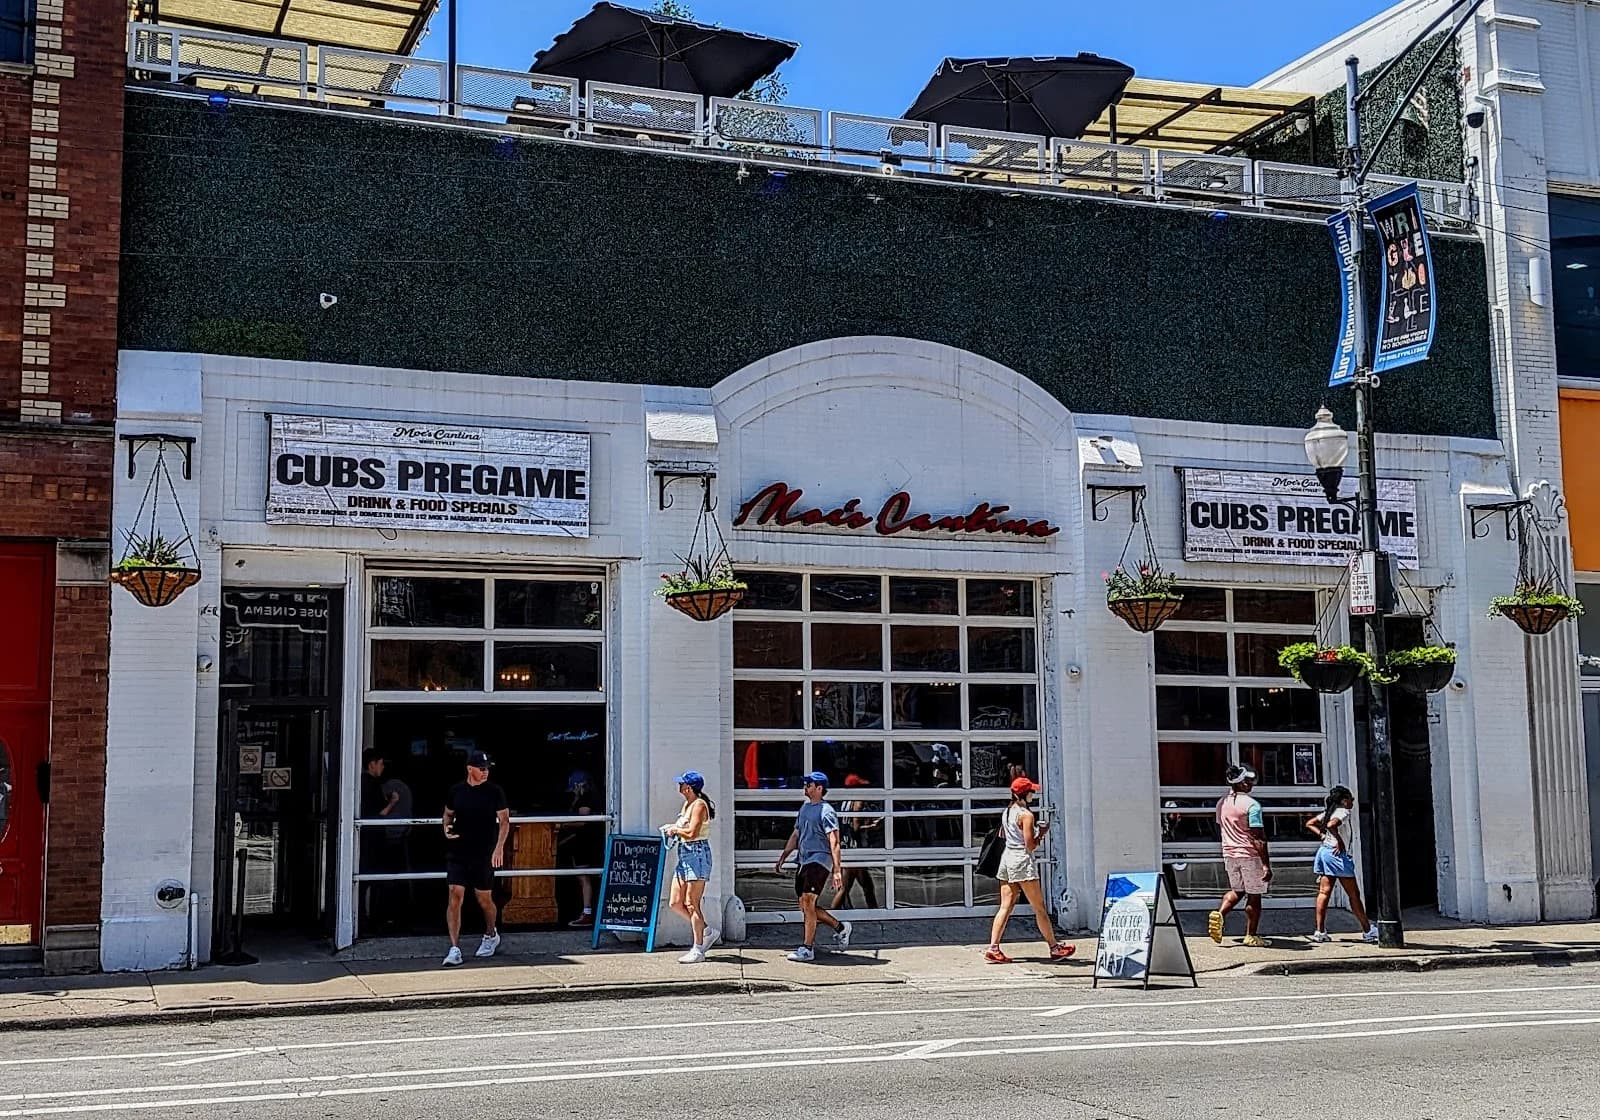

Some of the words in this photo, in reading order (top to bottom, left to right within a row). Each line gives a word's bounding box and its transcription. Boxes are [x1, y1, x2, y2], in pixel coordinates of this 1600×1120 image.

[393, 427, 432, 438] Moe's
[433, 429, 481, 440] Cantina
[276, 453, 386, 490] CUBS
[397, 460, 587, 500] PREGAME
[347, 495, 392, 510] DRINK
[395, 498, 406, 511] &
[409, 499, 448, 513] FOOD
[451, 500, 518, 516] SPECIALS
[875, 491, 1061, 538] Cantina
[1190, 501, 1269, 531] CUBS
[1277, 505, 1415, 538] PREGME
[1243, 536, 1274, 548] DRINK
[1277, 537, 1285, 549] &
[1287, 538, 1315, 549] FOOD
[630, 859, 646, 869] the
[607, 905, 619, 914] the
[1125, 928, 1142, 941] OPEN
